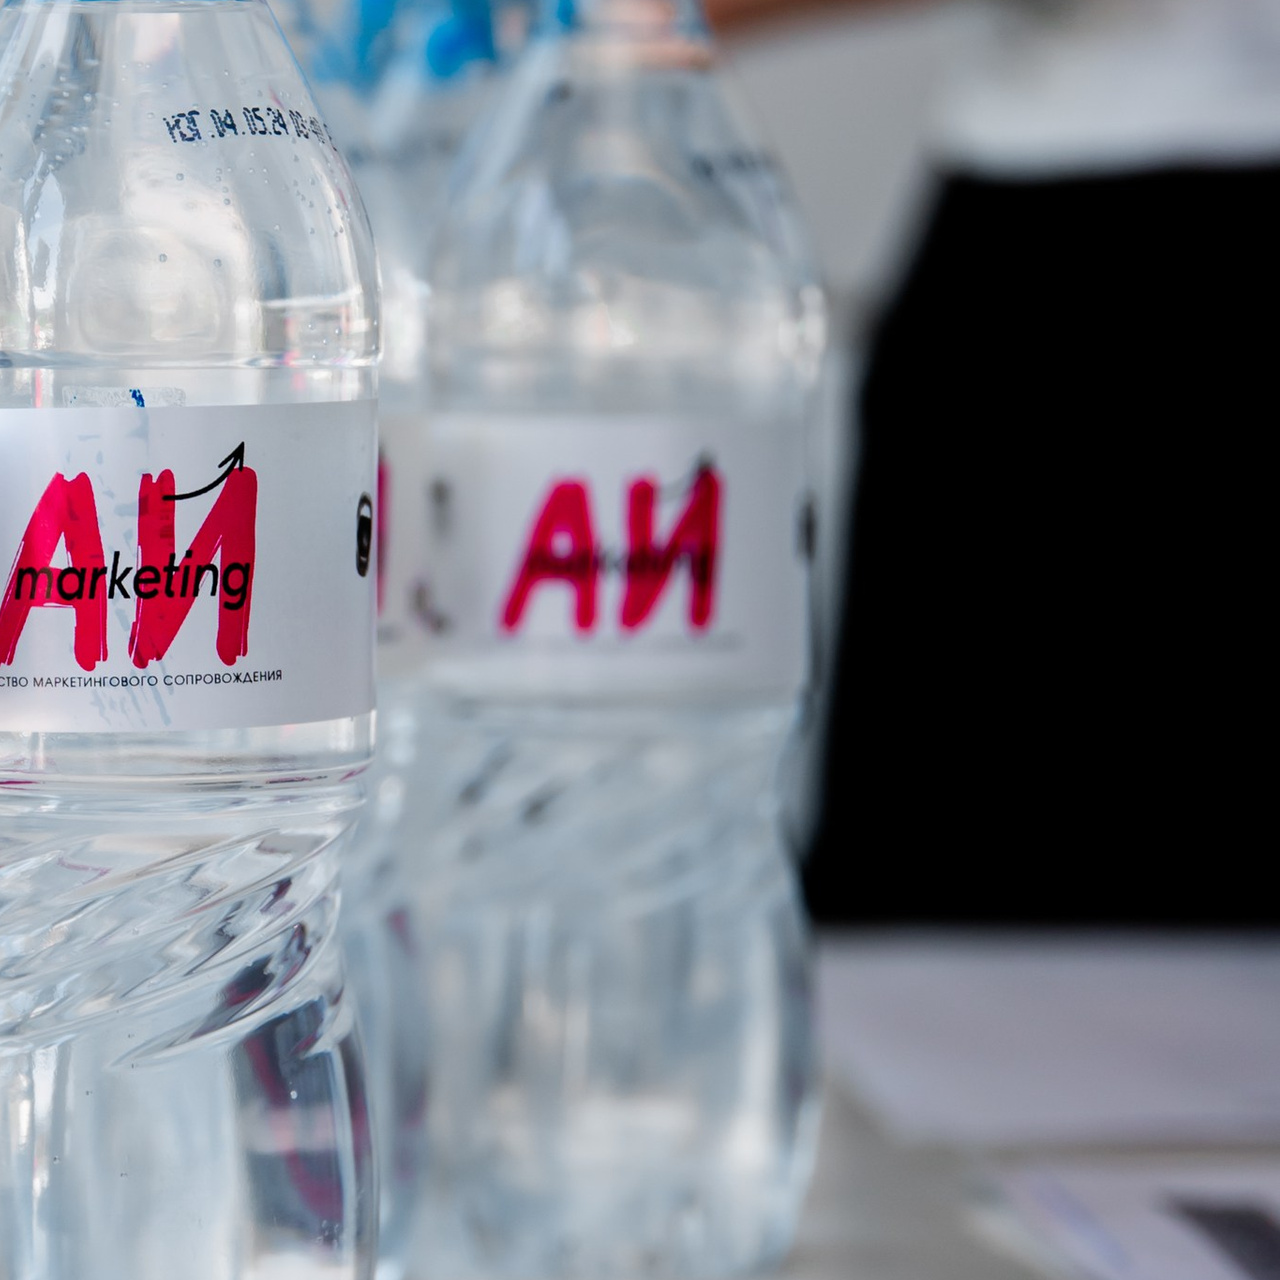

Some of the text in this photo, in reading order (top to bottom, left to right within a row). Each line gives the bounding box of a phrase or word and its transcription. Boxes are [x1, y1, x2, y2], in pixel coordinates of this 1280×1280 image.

[15, 550, 252, 609] marketing
[33, 675, 158, 687] МАРКЕТИНГОВОГО
[163, 669, 283, 686] СОПРОВОЖДЕНИЯ
